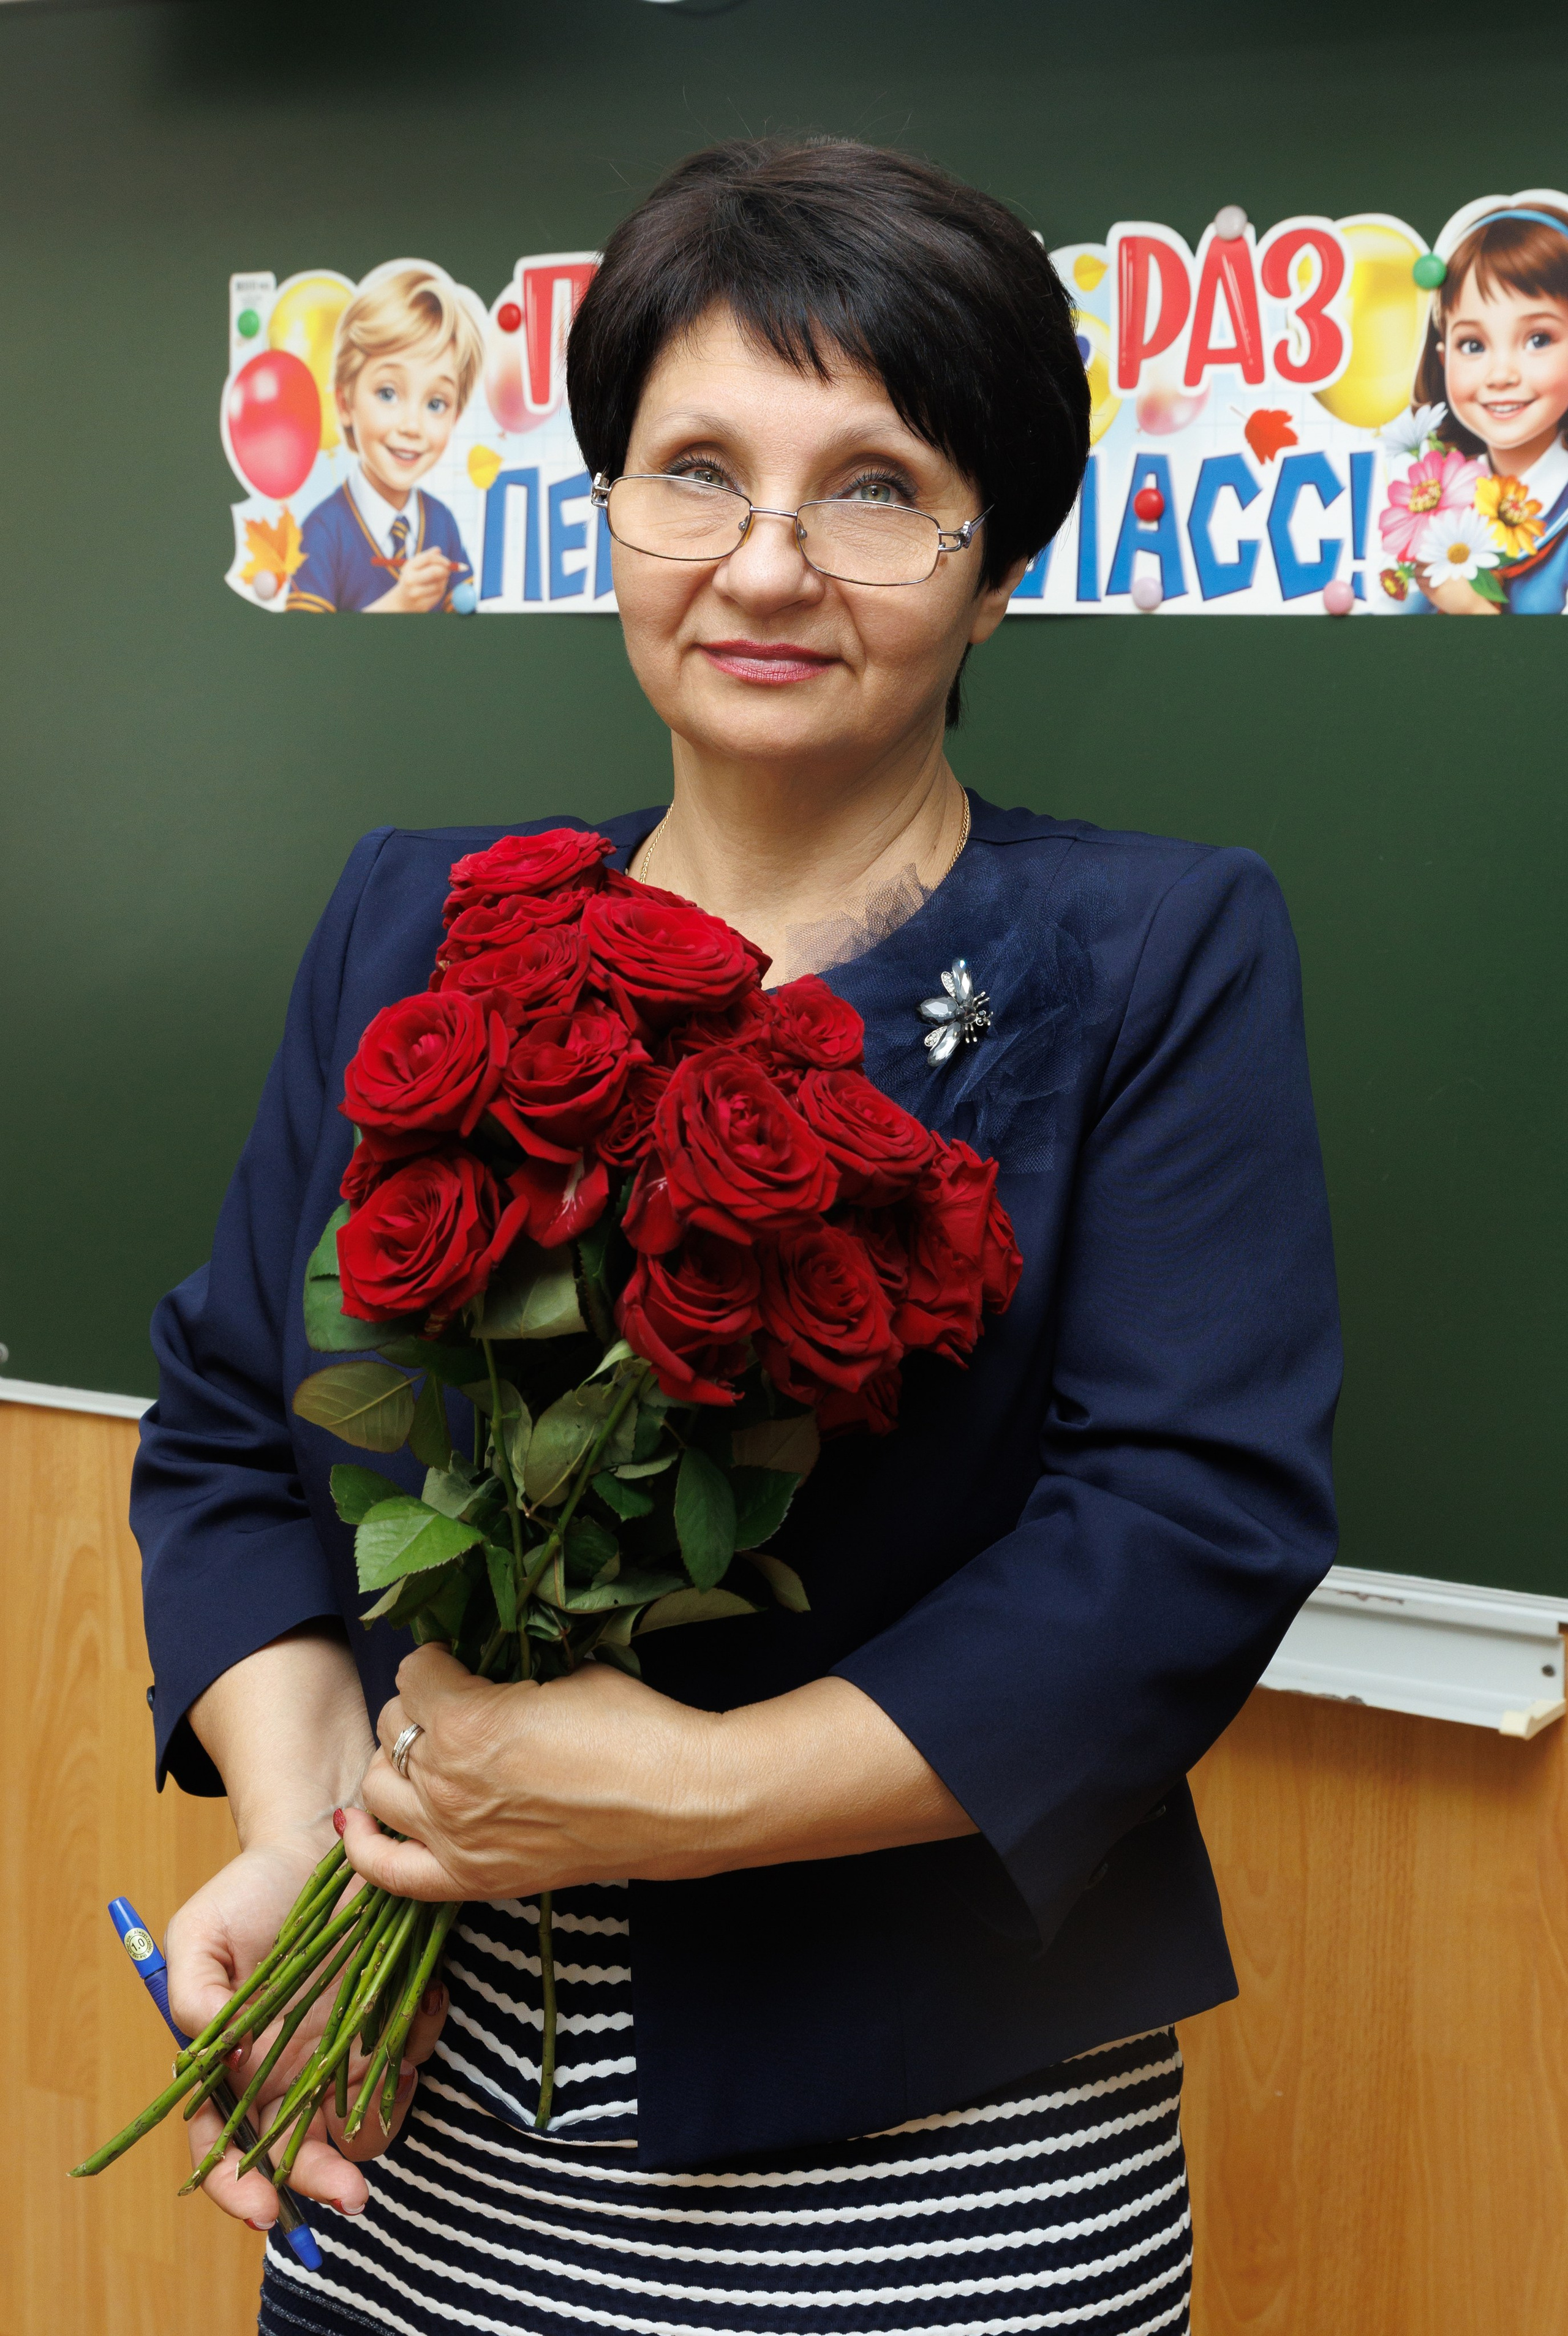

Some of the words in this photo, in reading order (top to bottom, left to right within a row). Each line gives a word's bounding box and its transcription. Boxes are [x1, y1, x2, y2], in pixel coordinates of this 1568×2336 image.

[1118, 228, 1344, 390] РАЗ
[481, 467, 613, 601] ПЕ
[1011, 451, 1376, 602] ЛАСС!
[131, 1939, 145, 1951] 1.0
